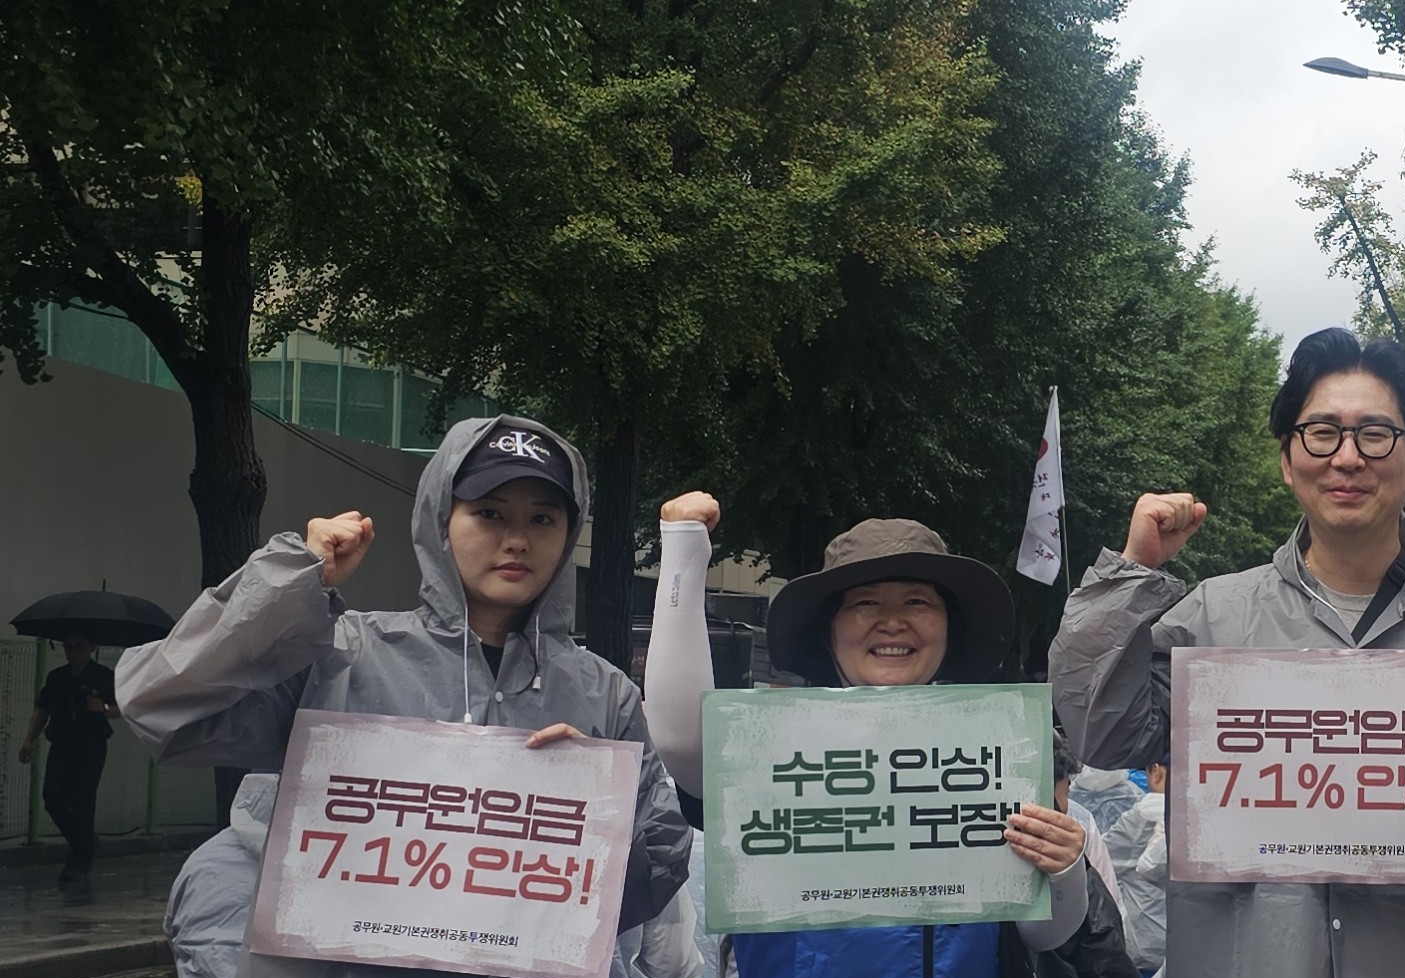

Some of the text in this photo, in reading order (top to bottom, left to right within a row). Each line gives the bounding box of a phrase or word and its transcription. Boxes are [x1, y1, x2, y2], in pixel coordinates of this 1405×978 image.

[772, 747, 1002, 798] 수당 인상!
[1199, 763, 1345, 810] 7.1%
[325, 775, 588, 847] 공무원임금
[740, 806, 896, 856] 생존권
[299, 829, 594, 905] 7.1% 인상!
